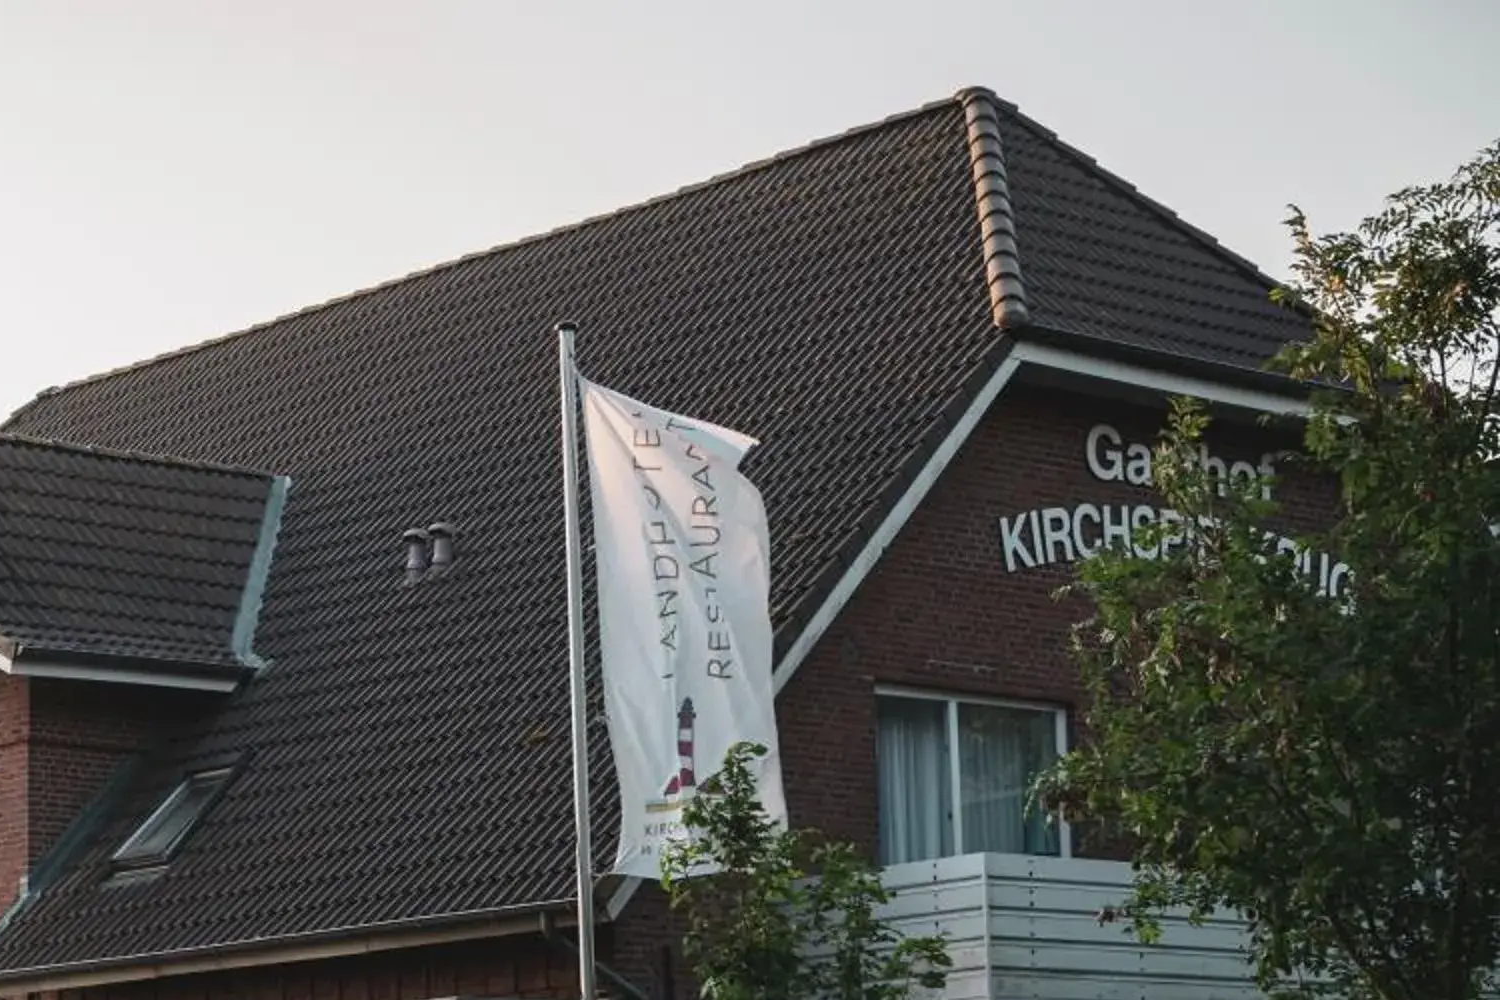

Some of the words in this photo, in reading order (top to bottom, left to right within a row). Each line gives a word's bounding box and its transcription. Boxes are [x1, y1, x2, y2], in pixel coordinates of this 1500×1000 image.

[1086, 423, 1276, 500] Gahof
[631, 411, 679, 679] ANDHTE
[1000, 502, 1354, 614] KIRCHSPUG
